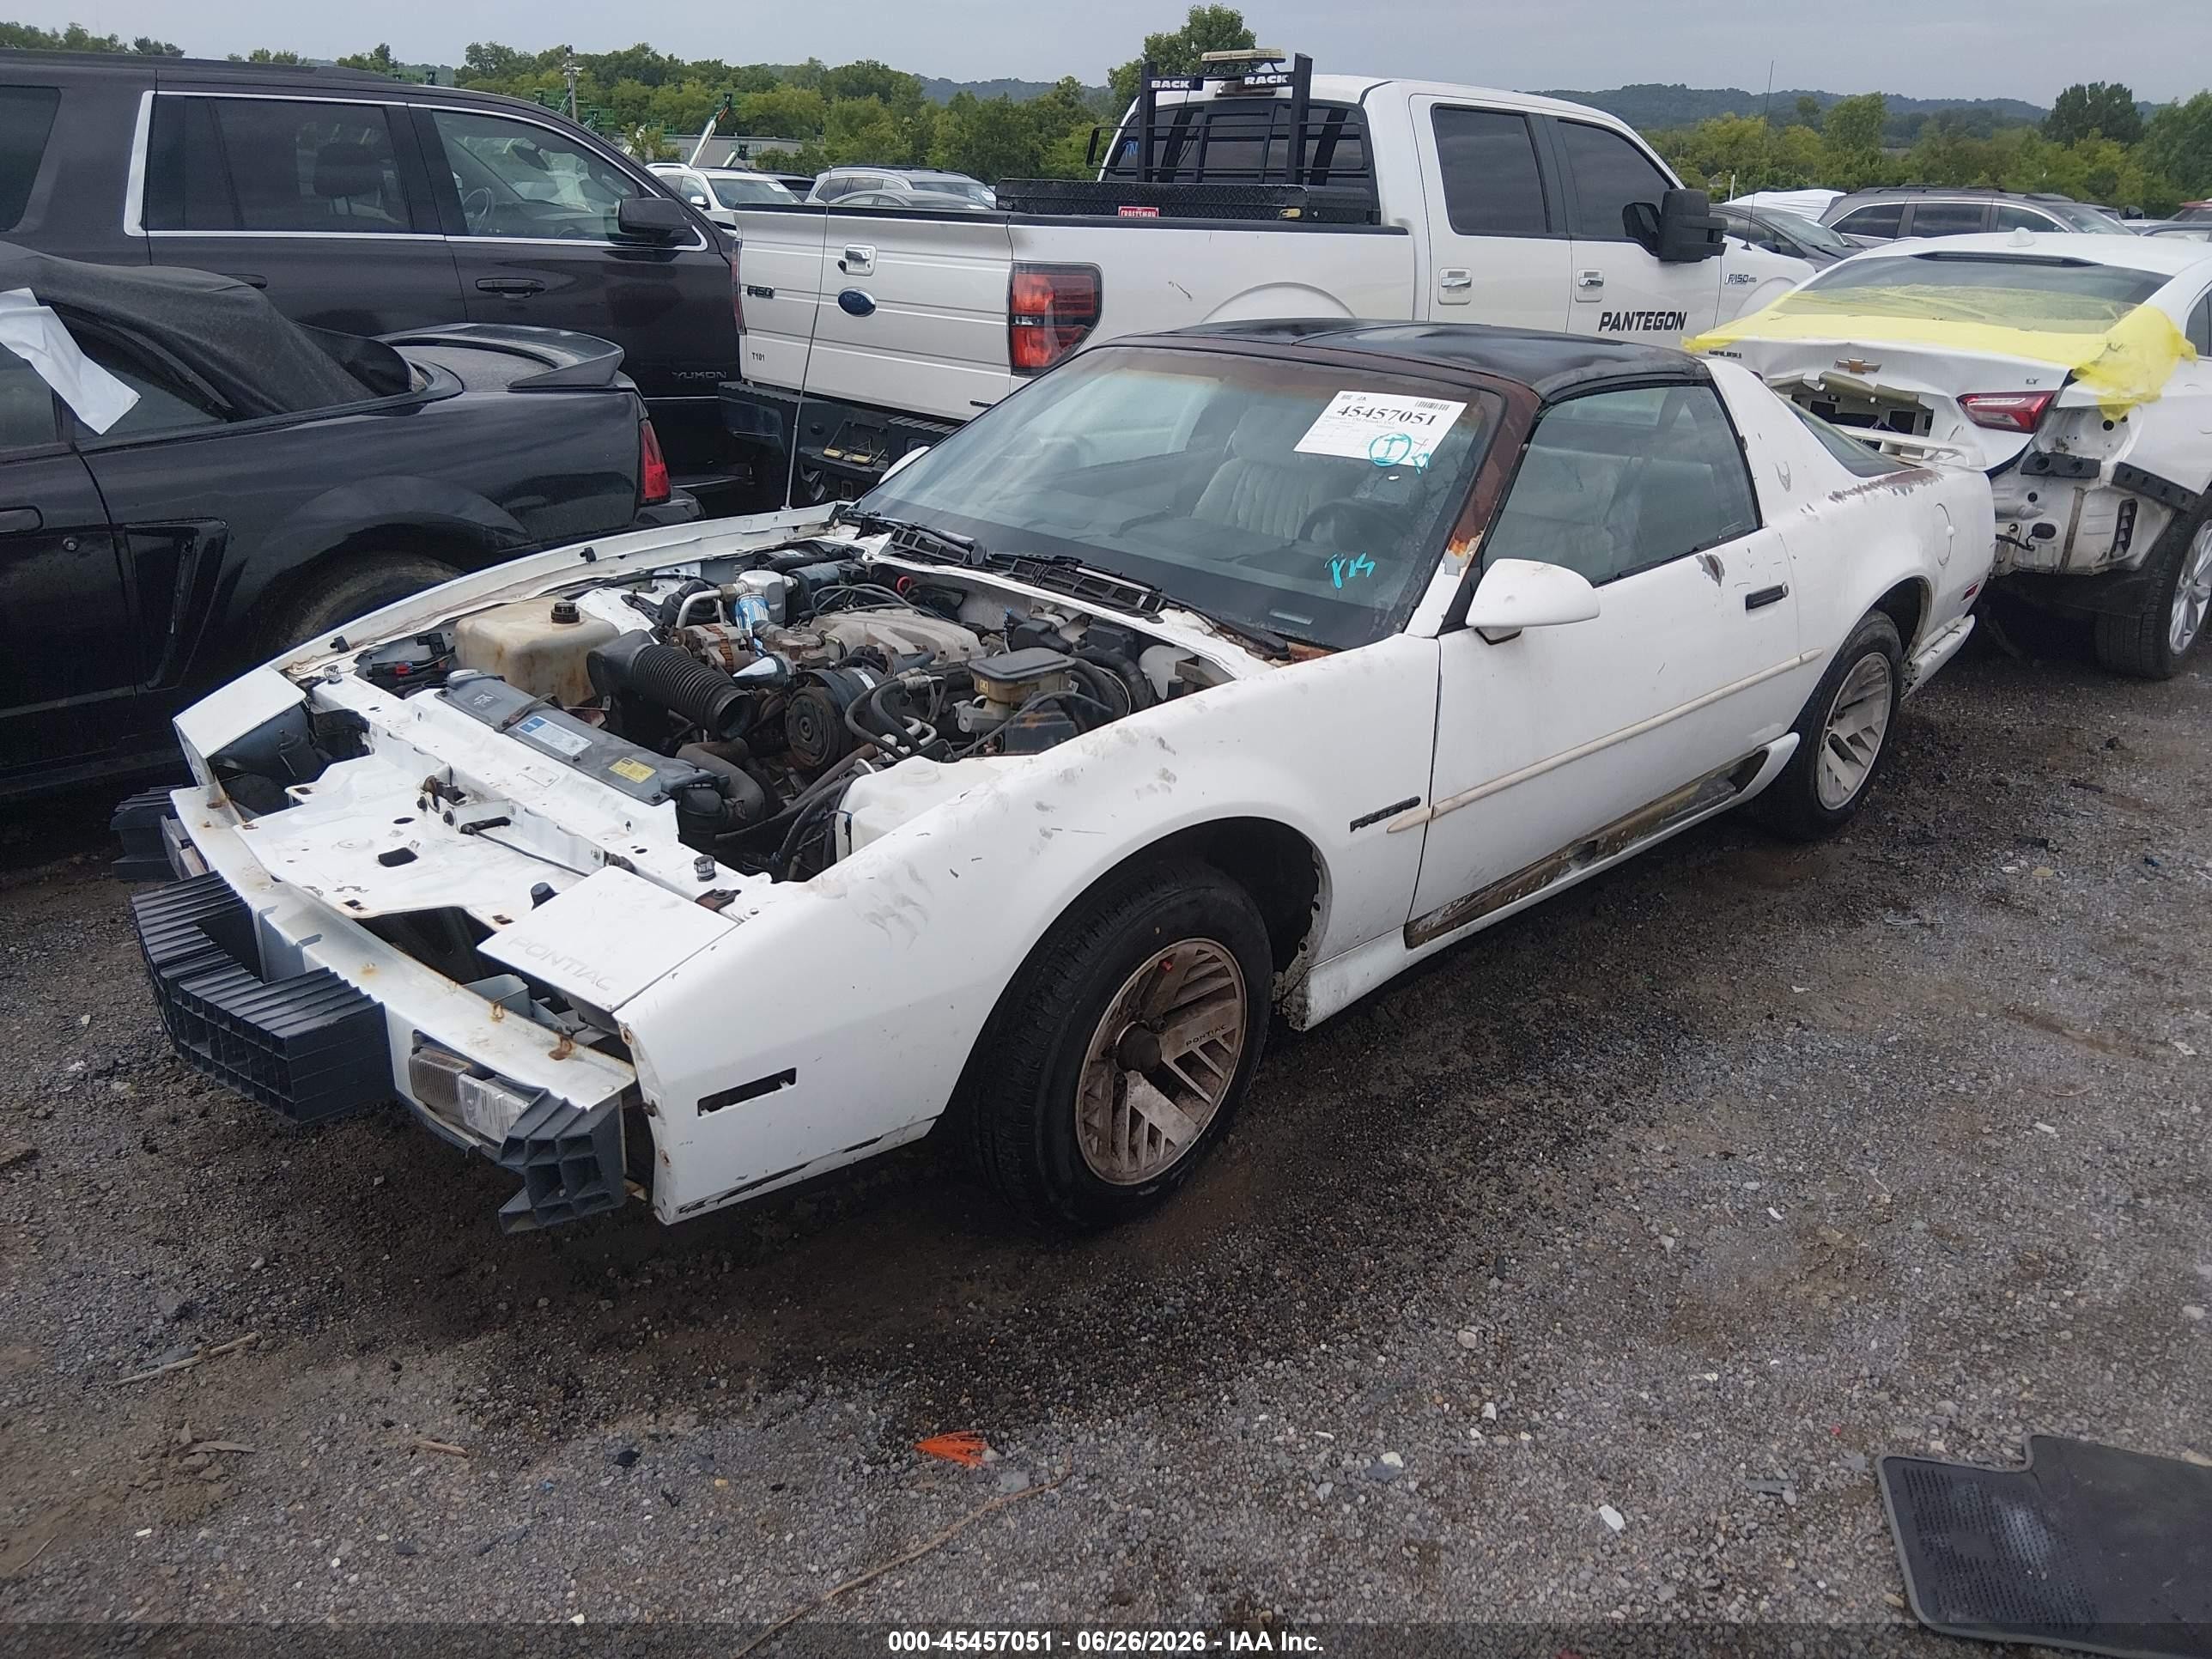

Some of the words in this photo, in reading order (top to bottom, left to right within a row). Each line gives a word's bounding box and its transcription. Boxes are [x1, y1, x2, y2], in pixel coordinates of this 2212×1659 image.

[1151, 80, 1190, 89] BACK
[1244, 75, 1289, 85] RACK
[1598, 311, 1687, 331] PANTEGON
[1337, 404, 1437, 426] 45457051
[507, 937, 615, 991] PONTIAC
[1185, 1024, 1228, 1047] PONTIAC
